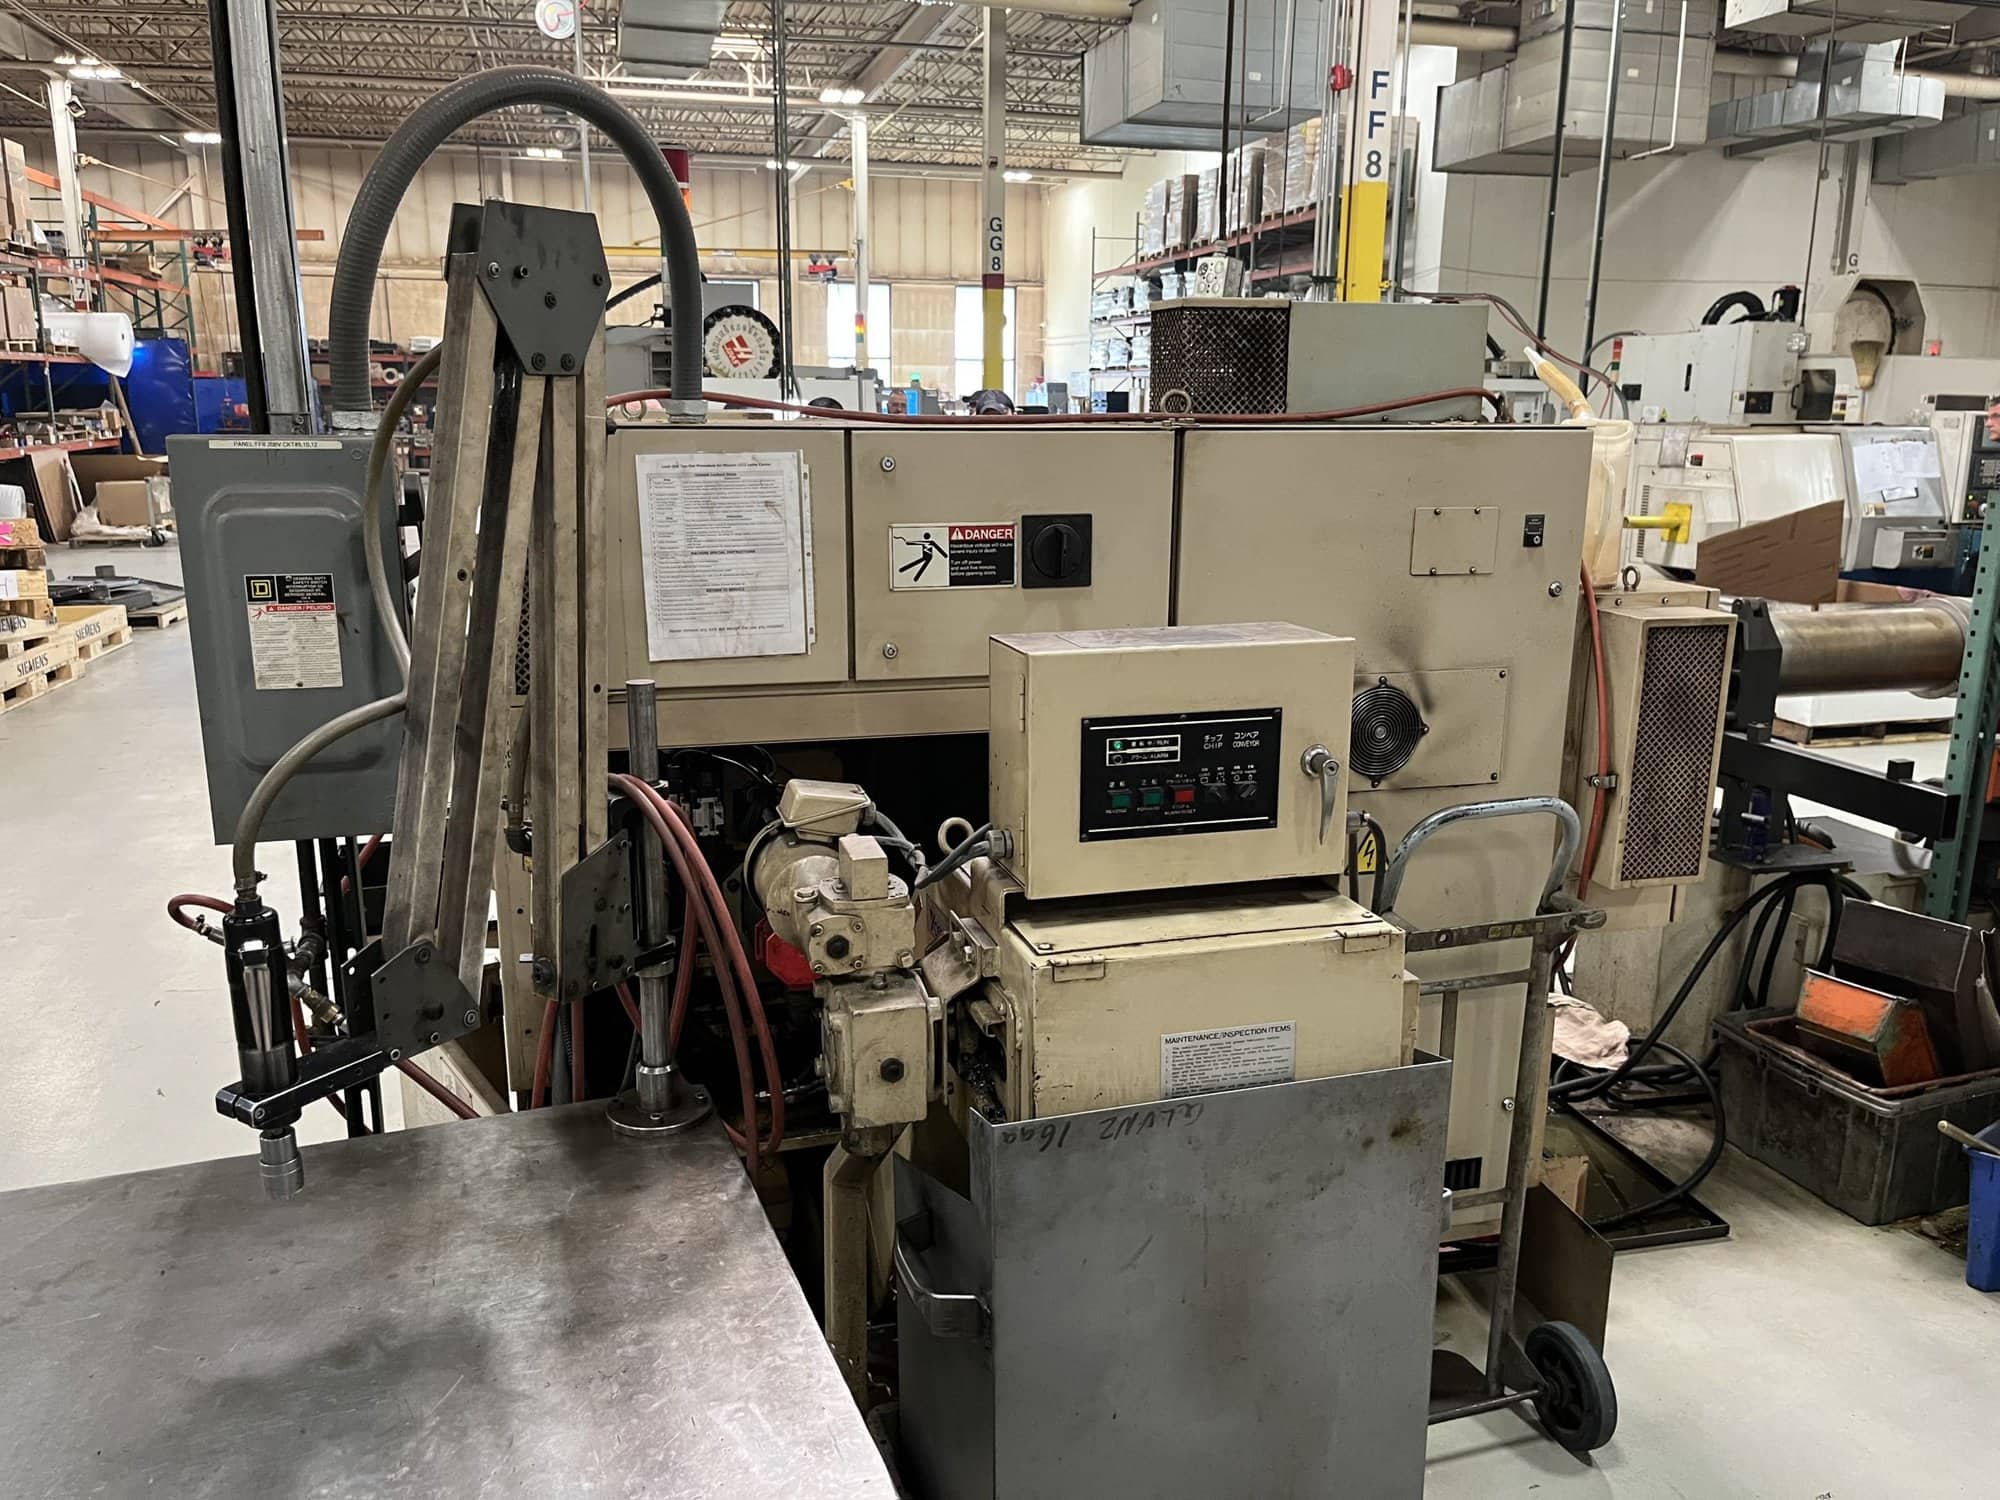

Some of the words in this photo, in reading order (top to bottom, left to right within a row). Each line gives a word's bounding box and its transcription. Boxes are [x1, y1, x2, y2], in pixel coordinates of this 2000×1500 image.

[965, 528, 1014, 540] DANGER
[75, 622, 101, 640] SIEMENS
[17, 652, 48, 677] SIEMENS
